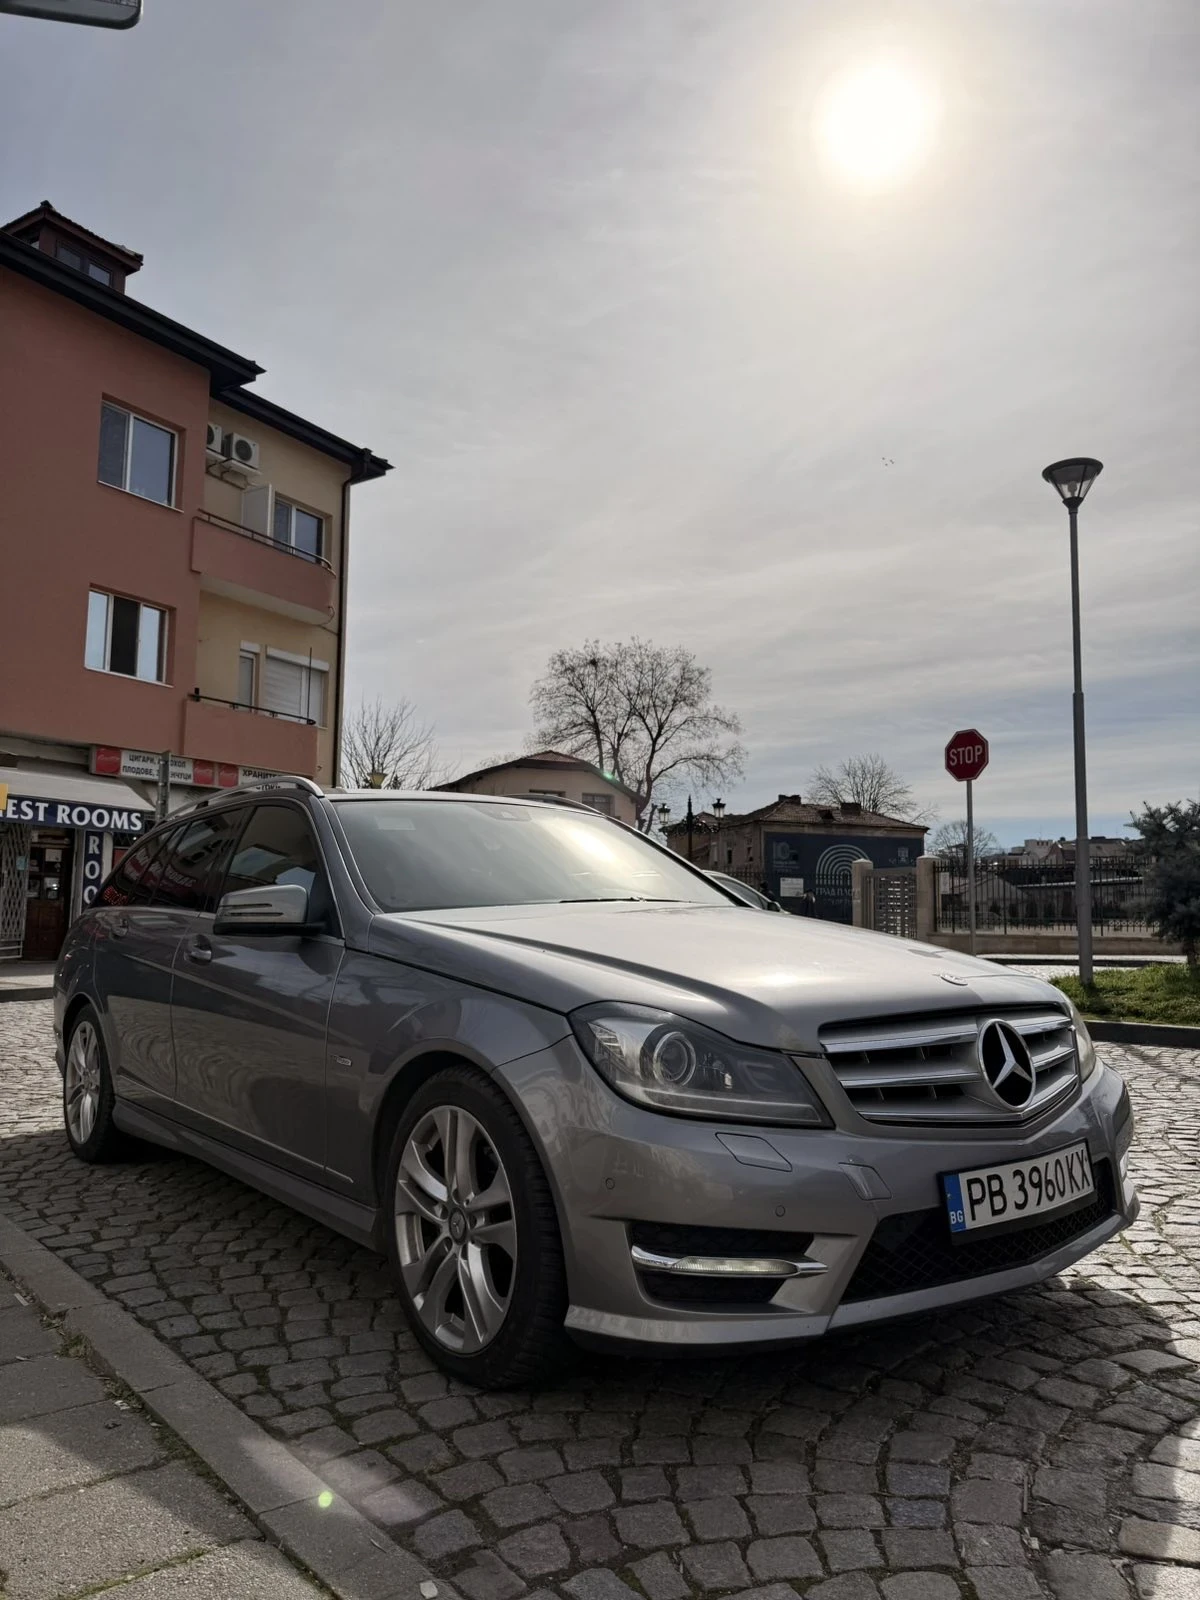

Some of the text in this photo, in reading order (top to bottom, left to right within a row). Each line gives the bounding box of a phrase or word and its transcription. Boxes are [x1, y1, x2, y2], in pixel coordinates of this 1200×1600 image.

[128, 754, 157, 765] ЦИГАРИ,
[950, 745, 983, 766] STOP
[122, 765, 155, 777] ПЛОДОВЕ,
[0, 799, 142, 831] EST ROOMS
[966, 1173, 1008, 1221] PB
[950, 1210, 964, 1225] BG
